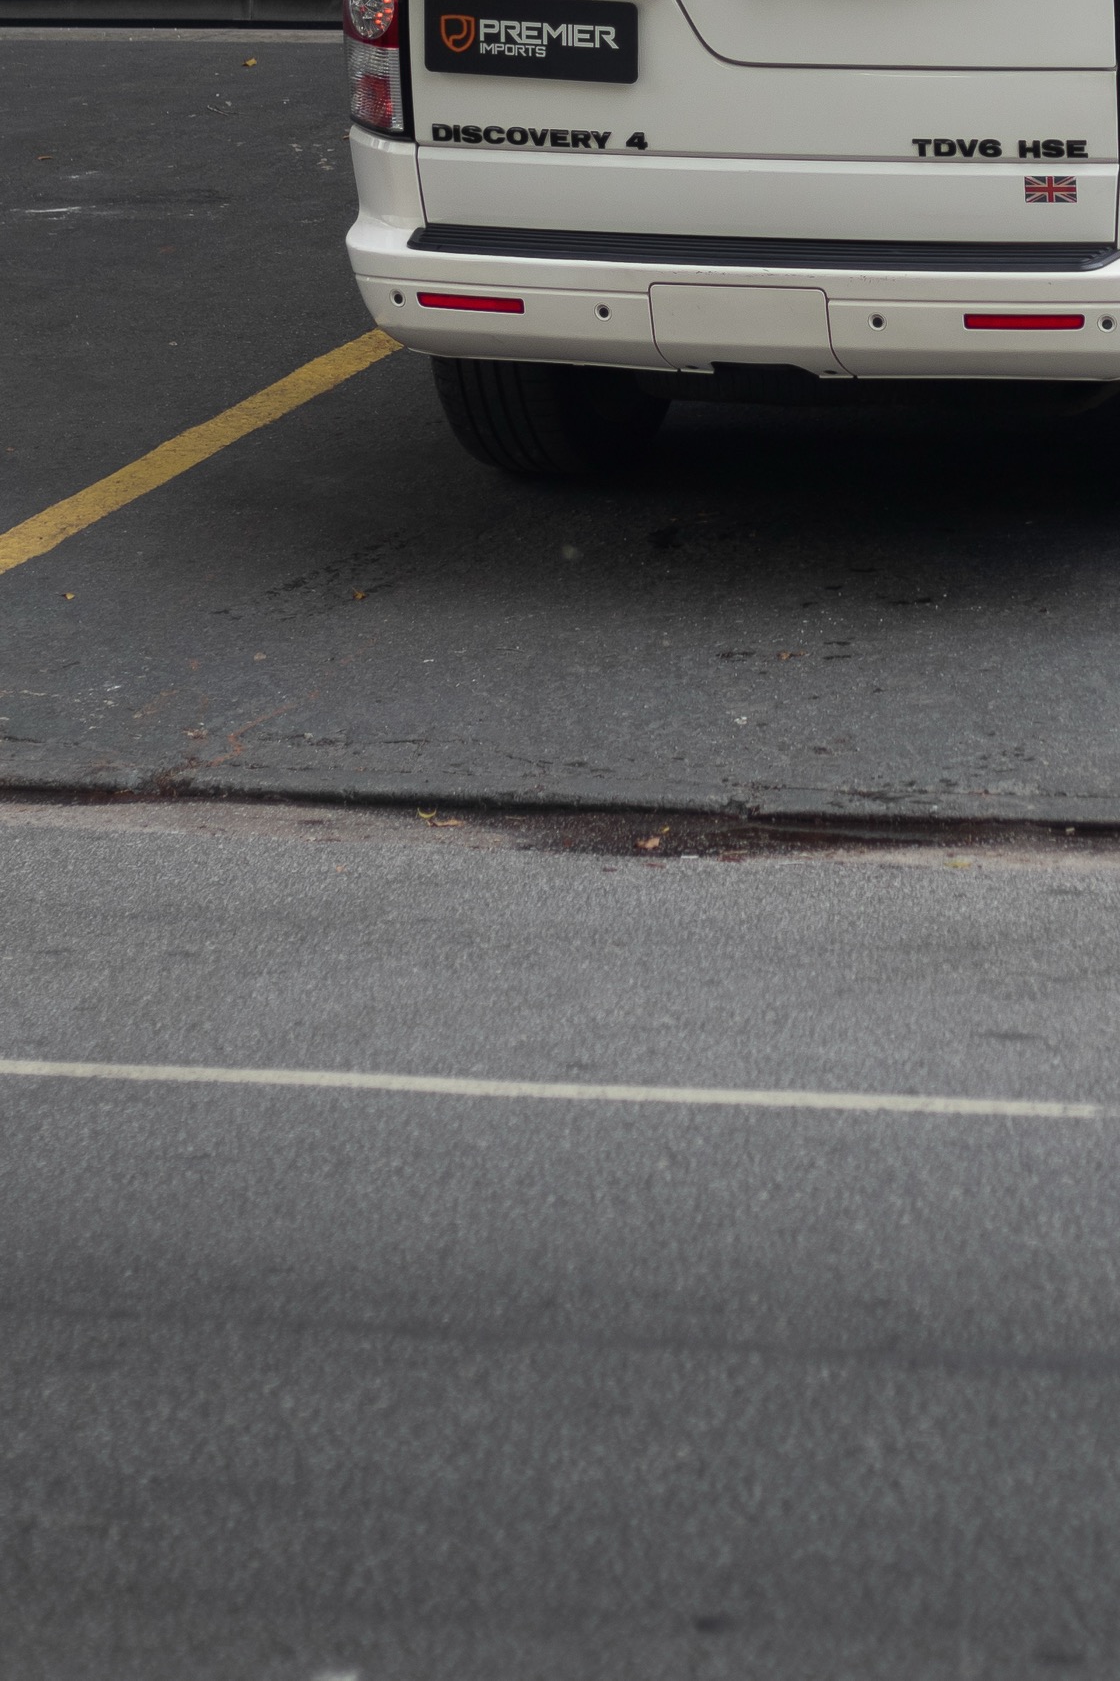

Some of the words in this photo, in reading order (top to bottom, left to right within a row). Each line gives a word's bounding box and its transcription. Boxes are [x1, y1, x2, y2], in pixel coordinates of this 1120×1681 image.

[479, 19, 620, 50] PREMIER
[479, 42, 547, 58] IMPORTS
[431, 123, 612, 150] DISCOVERY
[625, 131, 649, 151] 4
[912, 138, 1003, 158] TDV6
[1018, 139, 1089, 159] HSE
